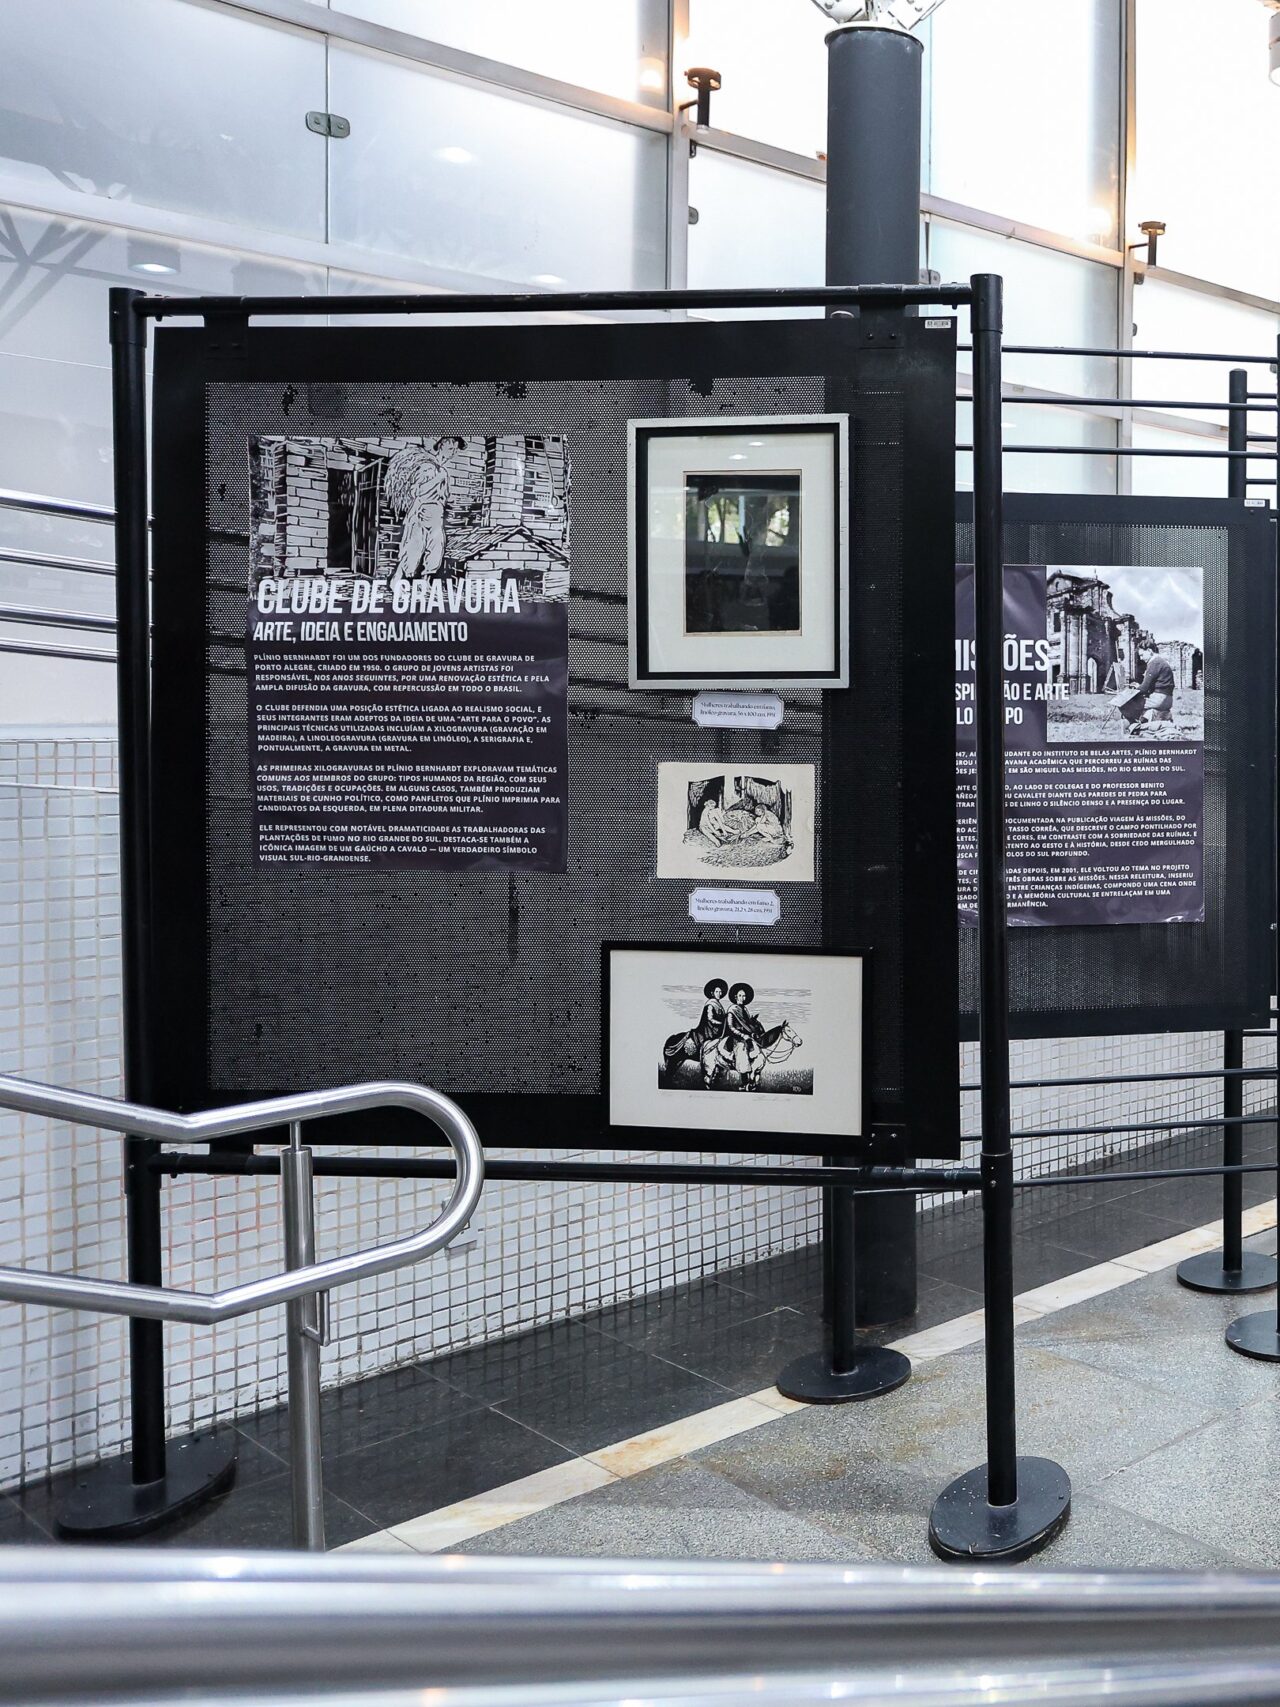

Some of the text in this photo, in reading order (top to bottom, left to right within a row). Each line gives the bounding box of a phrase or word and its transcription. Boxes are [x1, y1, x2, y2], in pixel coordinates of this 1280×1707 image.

[257, 578, 521, 614] CLUBE DE GRAVURA
[253, 621, 468, 643] ARTE, IDEIA E ENGAJAMENTO
[254, 653, 281, 661] PLÍNIO
[284, 664, 315, 672] ALEGRE,
[433, 665, 461, 673] JOVENS
[255, 672, 312, 682] RESPONSÁVEL,
[355, 674, 399, 682] SEGUINTES,
[438, 673, 486, 683] RENOVAÇÃO
[487, 673, 523, 682] ESTÉTICA
[286, 683, 318, 691] DIFUSÃO
[333, 684, 370, 692] GRAVURA,
[393, 683, 446, 692] REPERCUSSÃO
[1023, 683, 1032, 701] E
[1035, 683, 1070, 701] ARTE
[350, 703, 383, 713] POSIÇÃO
[385, 703, 420, 712] ESTÉTICA
[465, 705, 504, 713] REALISMO
[505, 706, 535, 714] SOCIAL,
[257, 724, 300, 732] PRINCIPAIS
[302, 723, 338, 732] TÉCNICAS
[386, 723, 425, 732] INCLUÍAM
[434, 725, 488, 733] XILOGRAVURA
[490, 724, 534, 734] (GRAVAÇÃO
[258, 745, 323, 753] PONTUALMENTE,
[1029, 757, 1068, 765] ACADÊMICA
[1133, 756, 1158, 764] RUÍNAS
[1076, 765, 1106, 774] MISSÕES,
